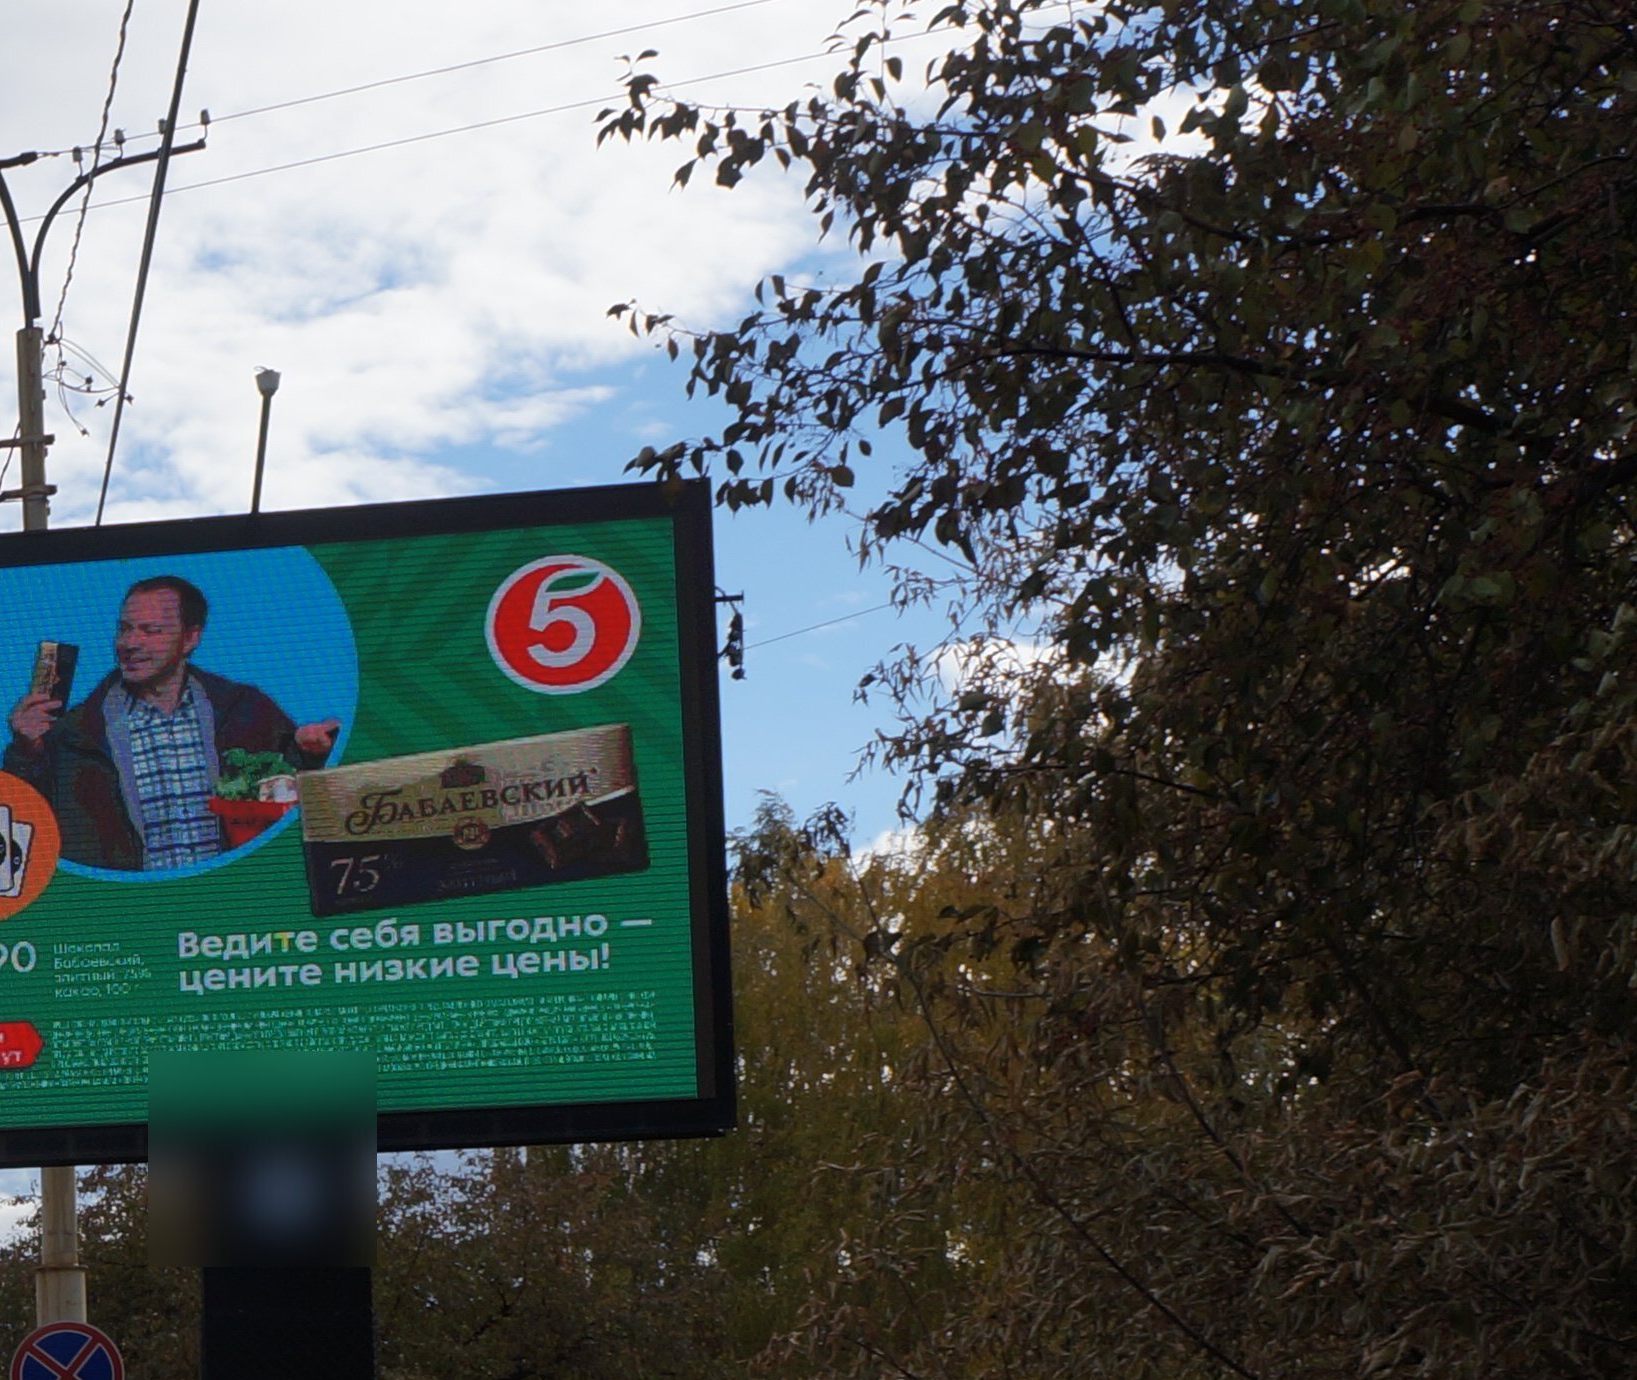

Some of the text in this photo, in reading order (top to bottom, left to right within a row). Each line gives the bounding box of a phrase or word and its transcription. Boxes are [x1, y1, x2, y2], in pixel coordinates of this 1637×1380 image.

[526, 567, 606, 669] 5
[177, 928, 319, 961] Ведите
[329, 917, 421, 951] себя
[432, 914, 609, 945] выгодно
[179, 942, 611, 997] цените низкие цены!
